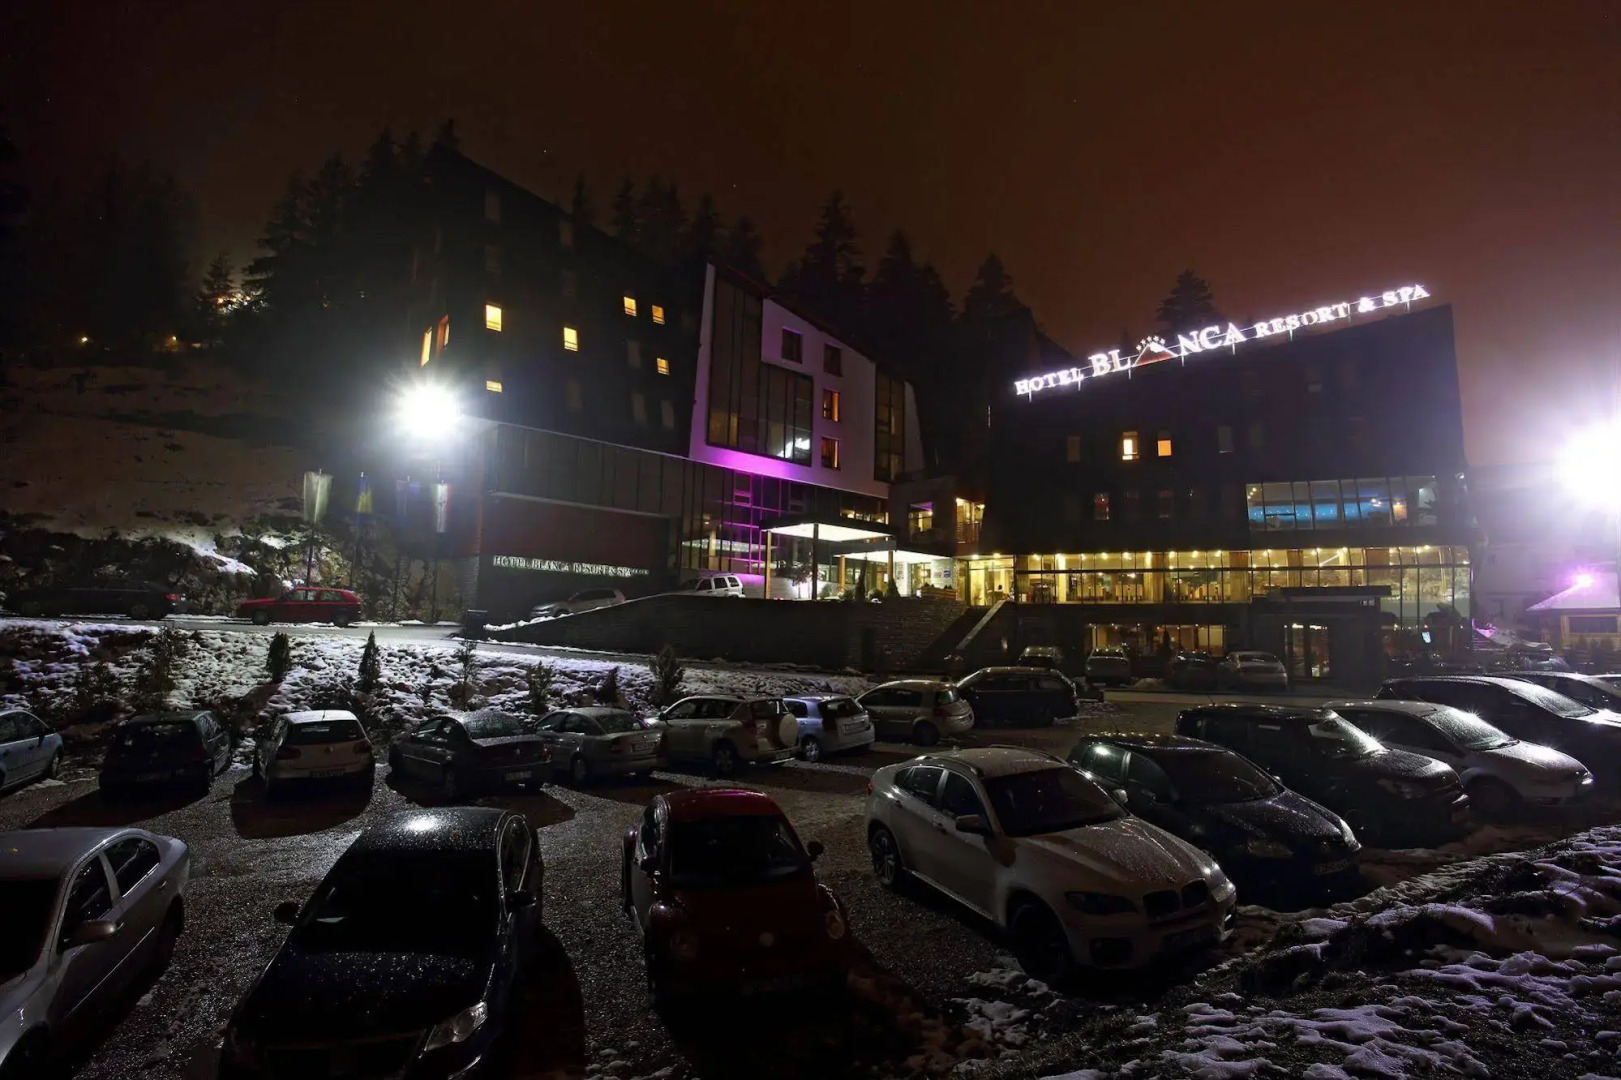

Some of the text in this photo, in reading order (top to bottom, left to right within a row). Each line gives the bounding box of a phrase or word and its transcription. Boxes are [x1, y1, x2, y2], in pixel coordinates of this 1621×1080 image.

[1014, 367, 1085, 396] HOTEL
[1253, 302, 1350, 339] RESORT
[1357, 296, 1376, 313] &
[1381, 284, 1431, 307] SPA
